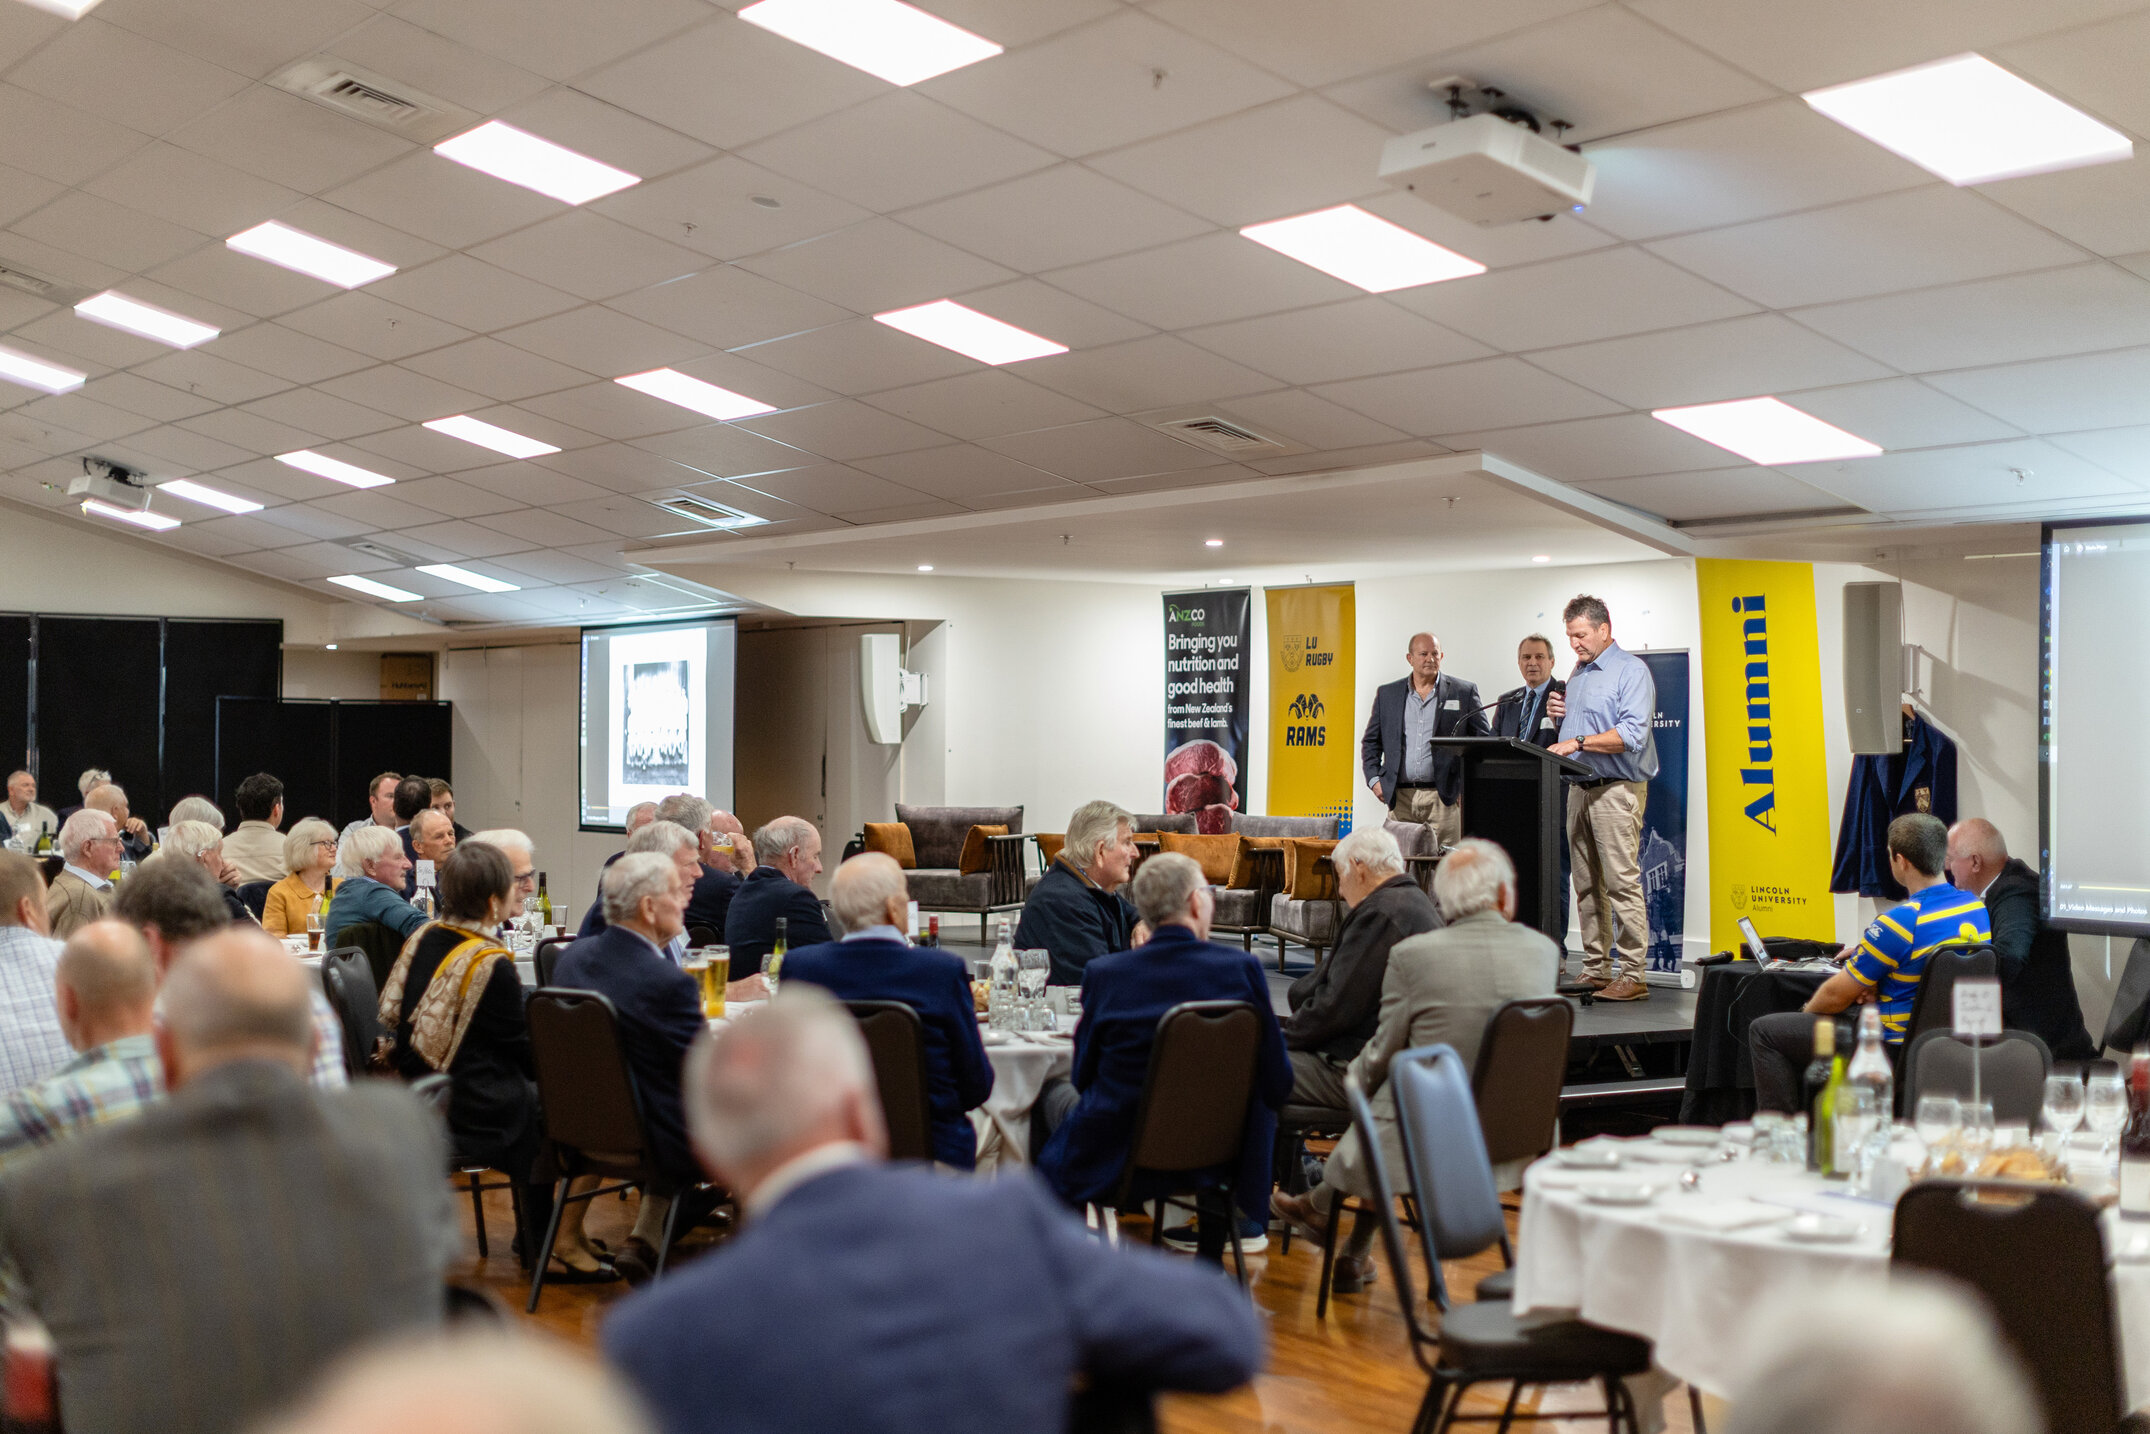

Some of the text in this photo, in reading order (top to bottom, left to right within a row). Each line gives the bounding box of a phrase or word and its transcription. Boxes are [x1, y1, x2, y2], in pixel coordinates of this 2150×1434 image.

[1168, 608, 1205, 622] ANZCO
[1168, 633, 1238, 654] Bringing you
[1305, 636, 1318, 650] LU
[1168, 653, 1239, 672] nutrition and
[1305, 652, 1334, 666] RUGBY
[1167, 676, 1234, 699] good health
[1167, 703, 1185, 714] from
[1185, 703, 1201, 714] New
[1732, 593, 1776, 837] Alumni
[1167, 718, 1187, 728] finest
[1188, 717, 1203, 728] beef
[1203, 717, 1210, 728] &
[1286, 725, 1326, 747] RAMS
[1751, 885, 1790, 895] LINCOLN
[1751, 894, 1807, 905] UNIVERSITY
[1752, 904, 1774, 912] Alumni
